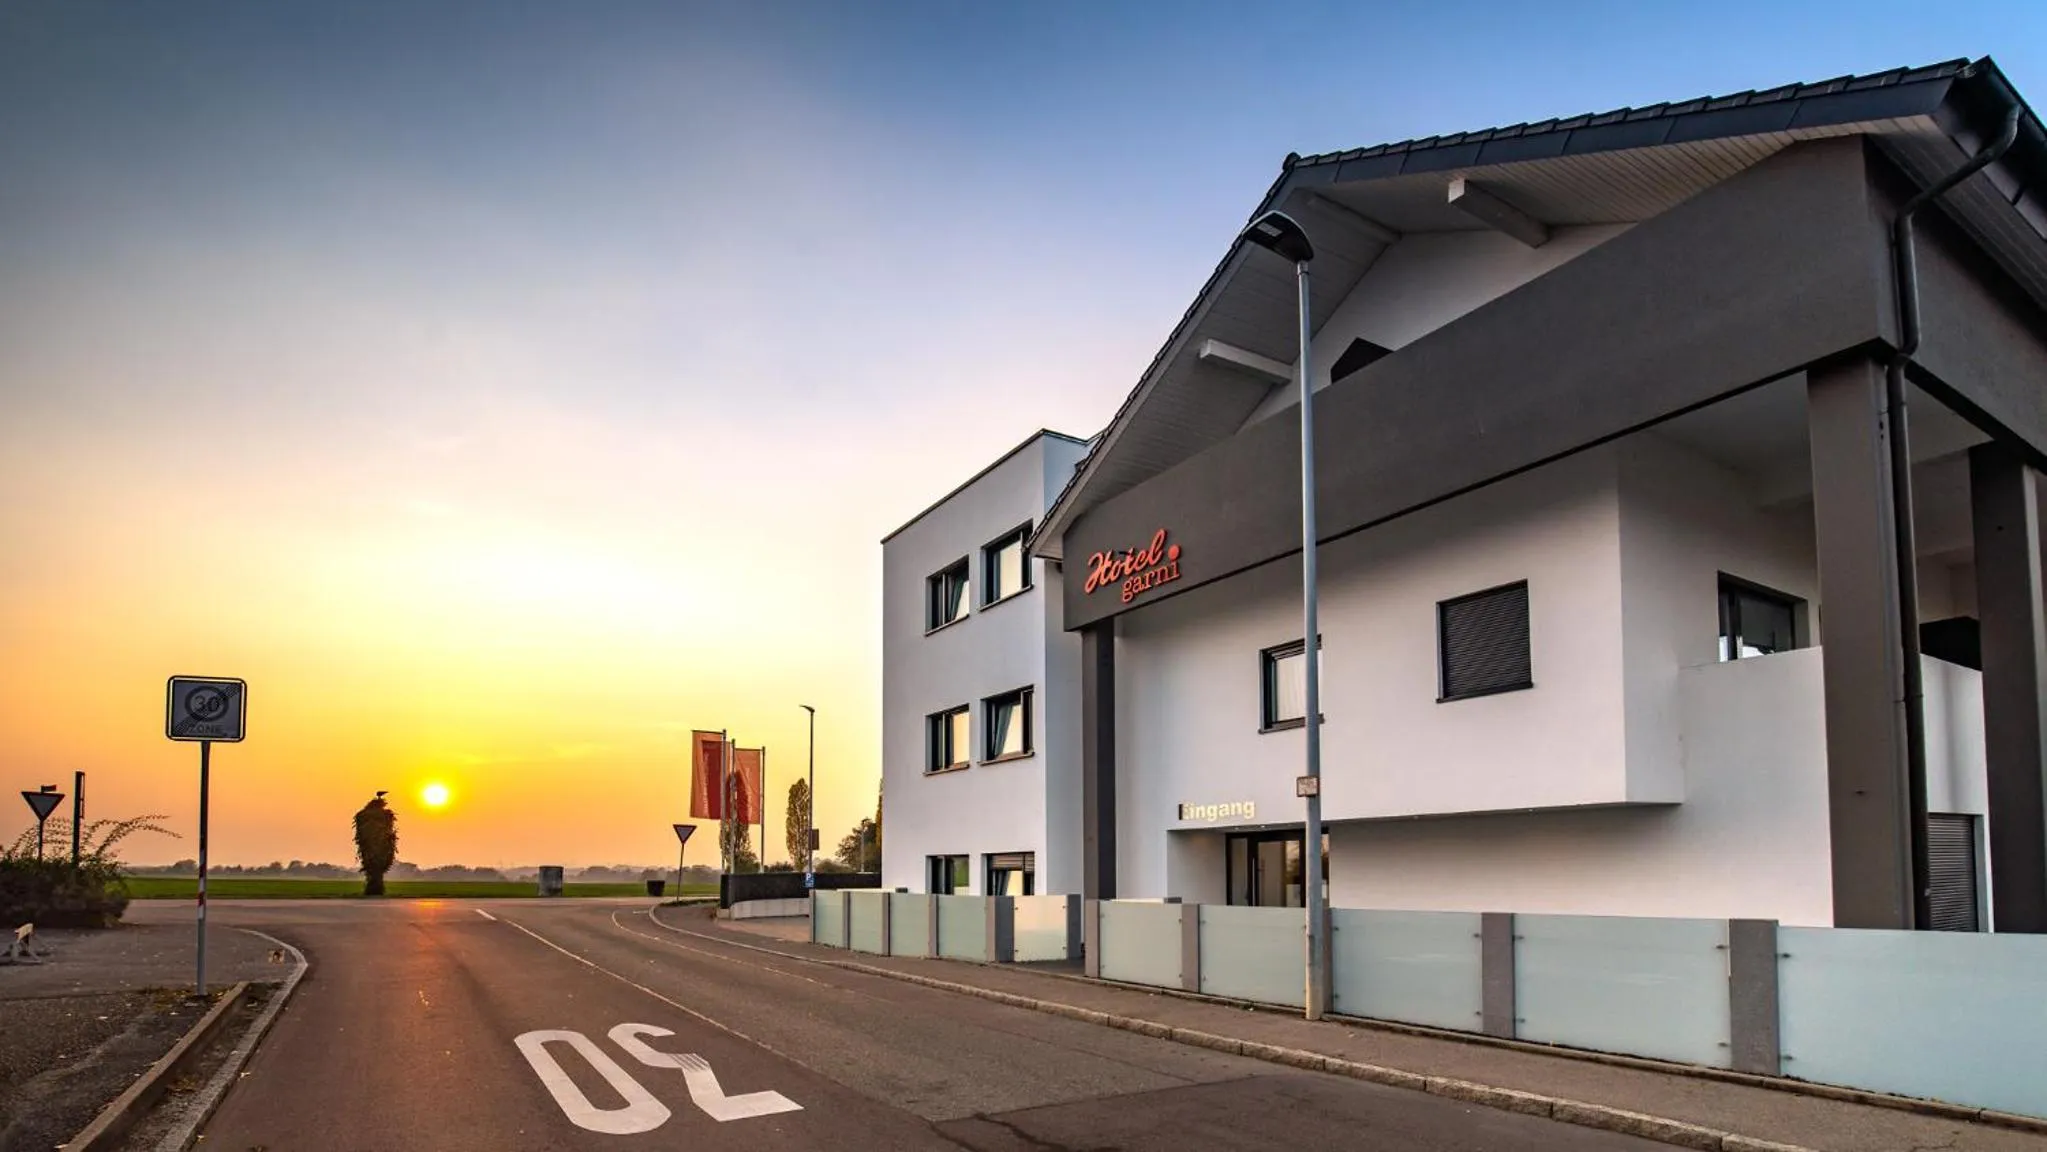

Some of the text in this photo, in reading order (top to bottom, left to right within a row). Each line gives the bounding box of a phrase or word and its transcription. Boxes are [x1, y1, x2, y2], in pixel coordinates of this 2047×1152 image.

[1084, 528, 1166, 594] Hotel
[1122, 545, 1181, 603] garni
[195, 695, 220, 713] 30
[187, 722, 223, 735] ZONE
